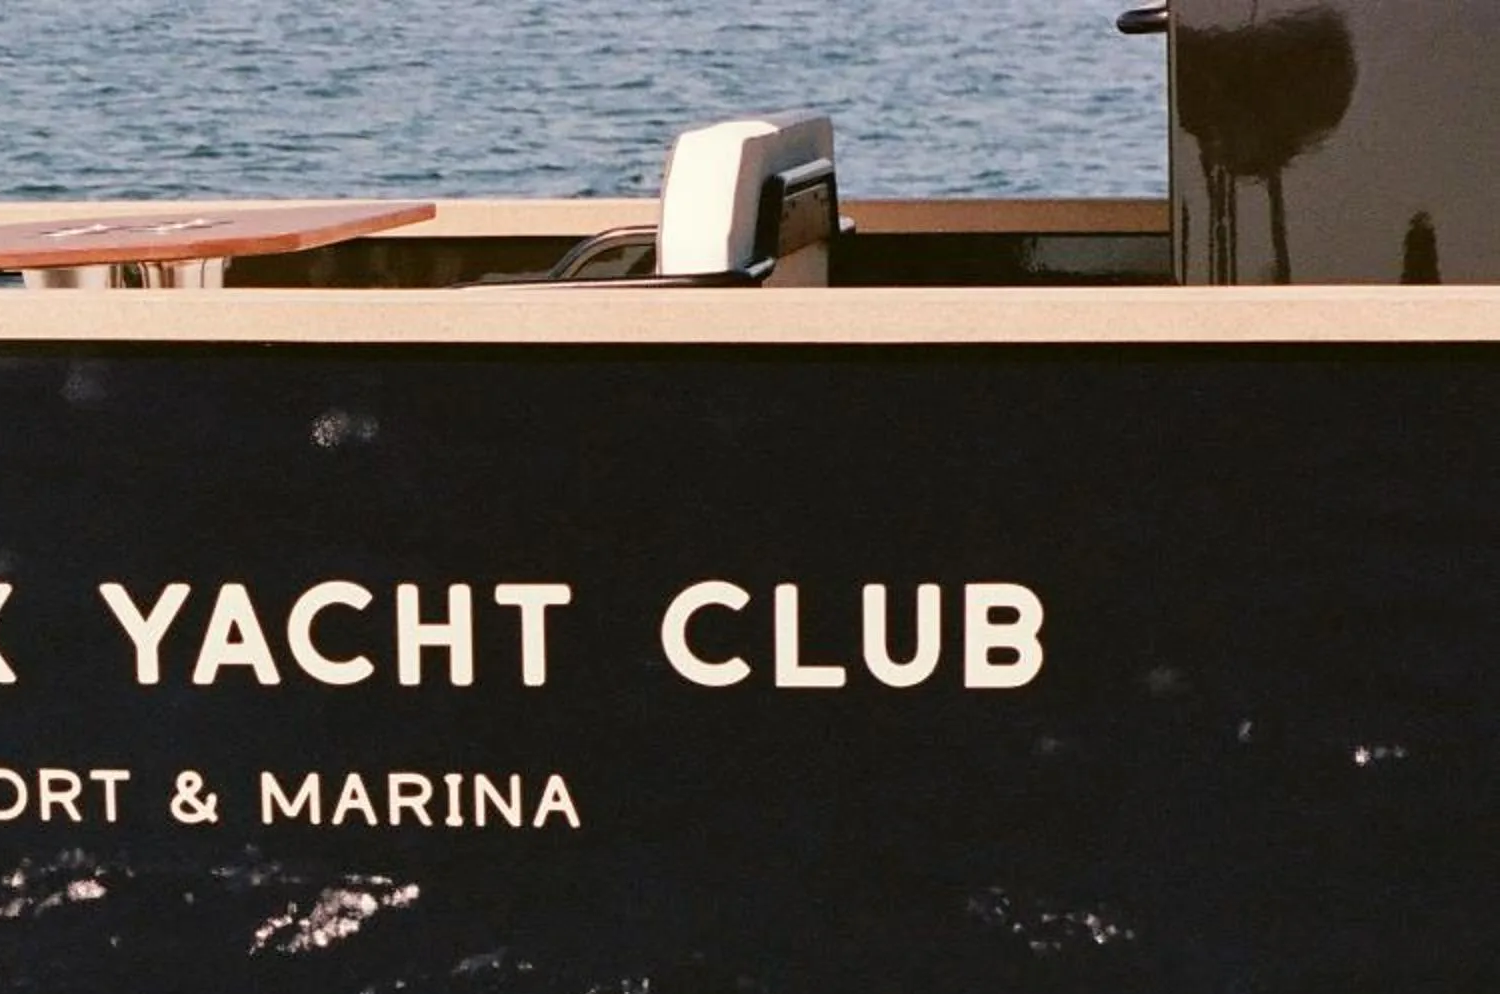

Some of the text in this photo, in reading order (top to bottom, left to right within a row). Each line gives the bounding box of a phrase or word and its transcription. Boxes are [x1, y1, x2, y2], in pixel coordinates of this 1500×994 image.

[98, 581, 572, 686] YACHT
[660, 581, 1045, 689] CLUB
[169, 770, 219, 824] &
[260, 772, 581, 829] MARINA
